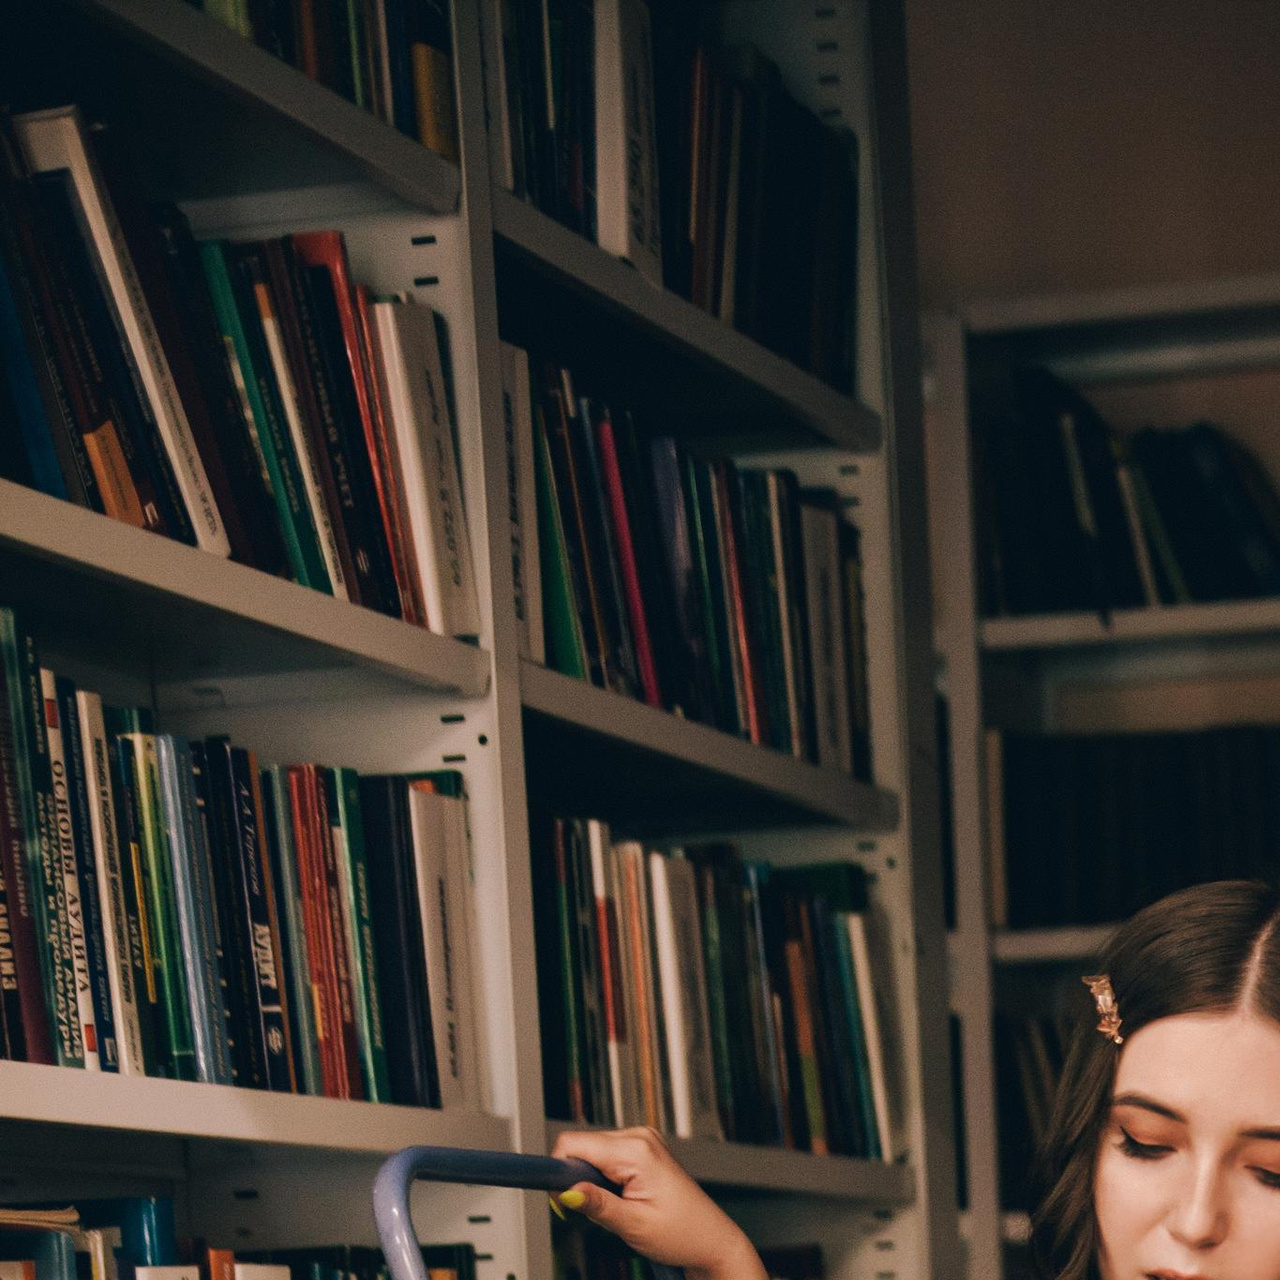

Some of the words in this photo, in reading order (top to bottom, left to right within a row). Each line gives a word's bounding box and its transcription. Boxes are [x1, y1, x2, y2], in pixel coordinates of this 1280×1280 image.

[36, 790, 53, 884] методы
[47, 918, 72, 1058] процедуры
[46, 793, 70, 960] ФИНАНСОВЫЙ
[65, 966, 83, 1059] АНАЛИЗ
[51, 759, 76, 875] ОСНОВЫ
[65, 891, 90, 992] АУДИТА
[127, 914, 143, 968] АУДИТ
[250, 924, 277, 990] АУДИТ
